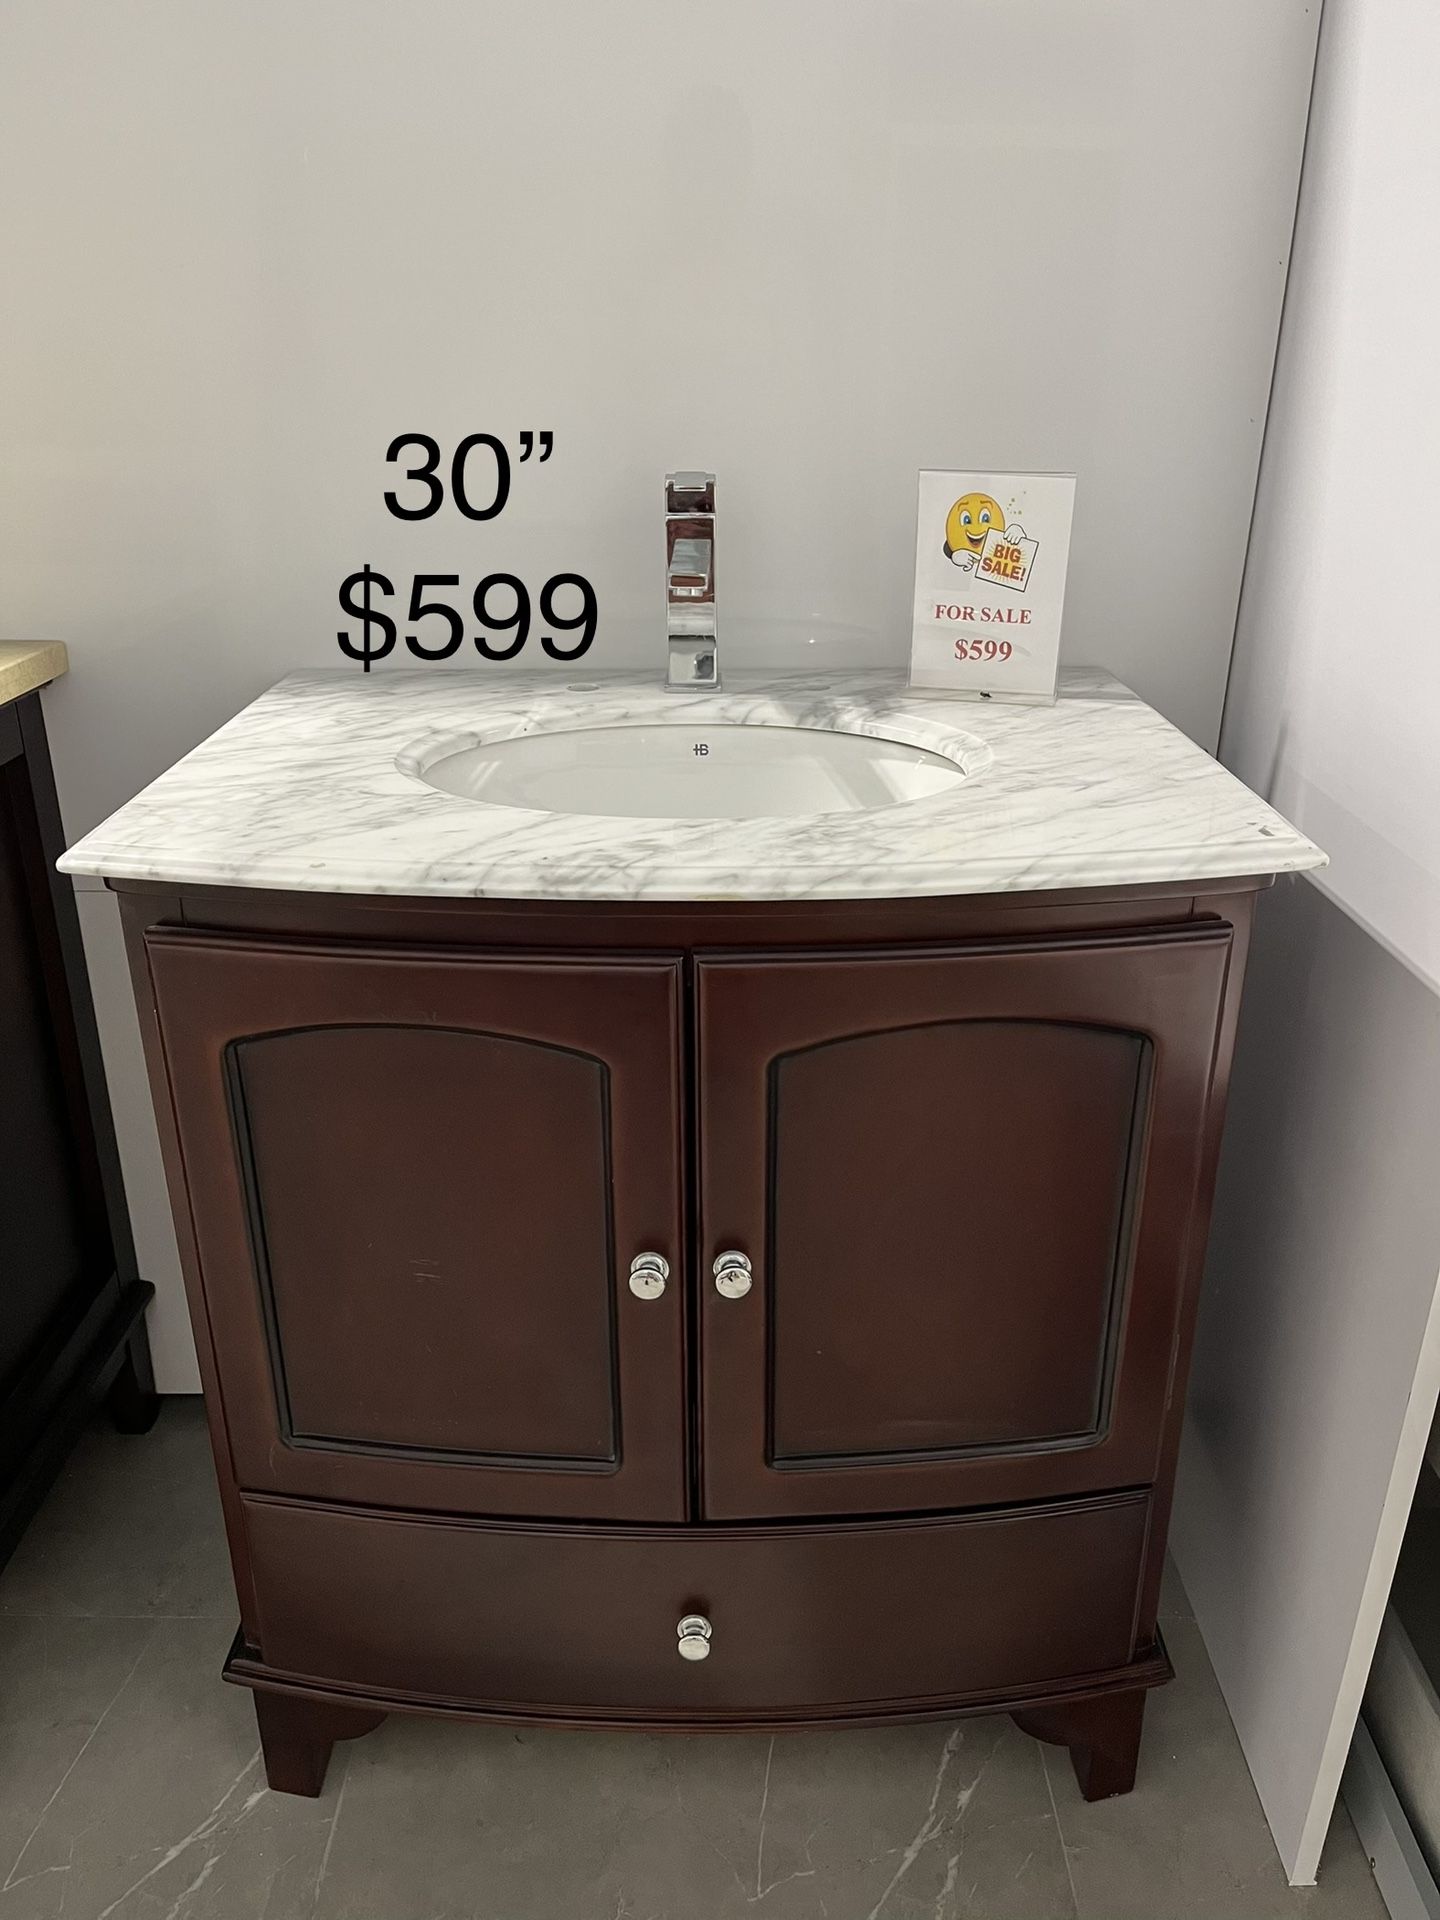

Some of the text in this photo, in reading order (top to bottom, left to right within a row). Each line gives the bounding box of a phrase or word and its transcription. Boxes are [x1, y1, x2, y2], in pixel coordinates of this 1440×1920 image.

[993, 543, 1021, 563] BIG
[981, 557, 1025, 582] SALE!
[935, 604, 1032, 624] FOR SALE
[954, 638, 1013, 662] $599
